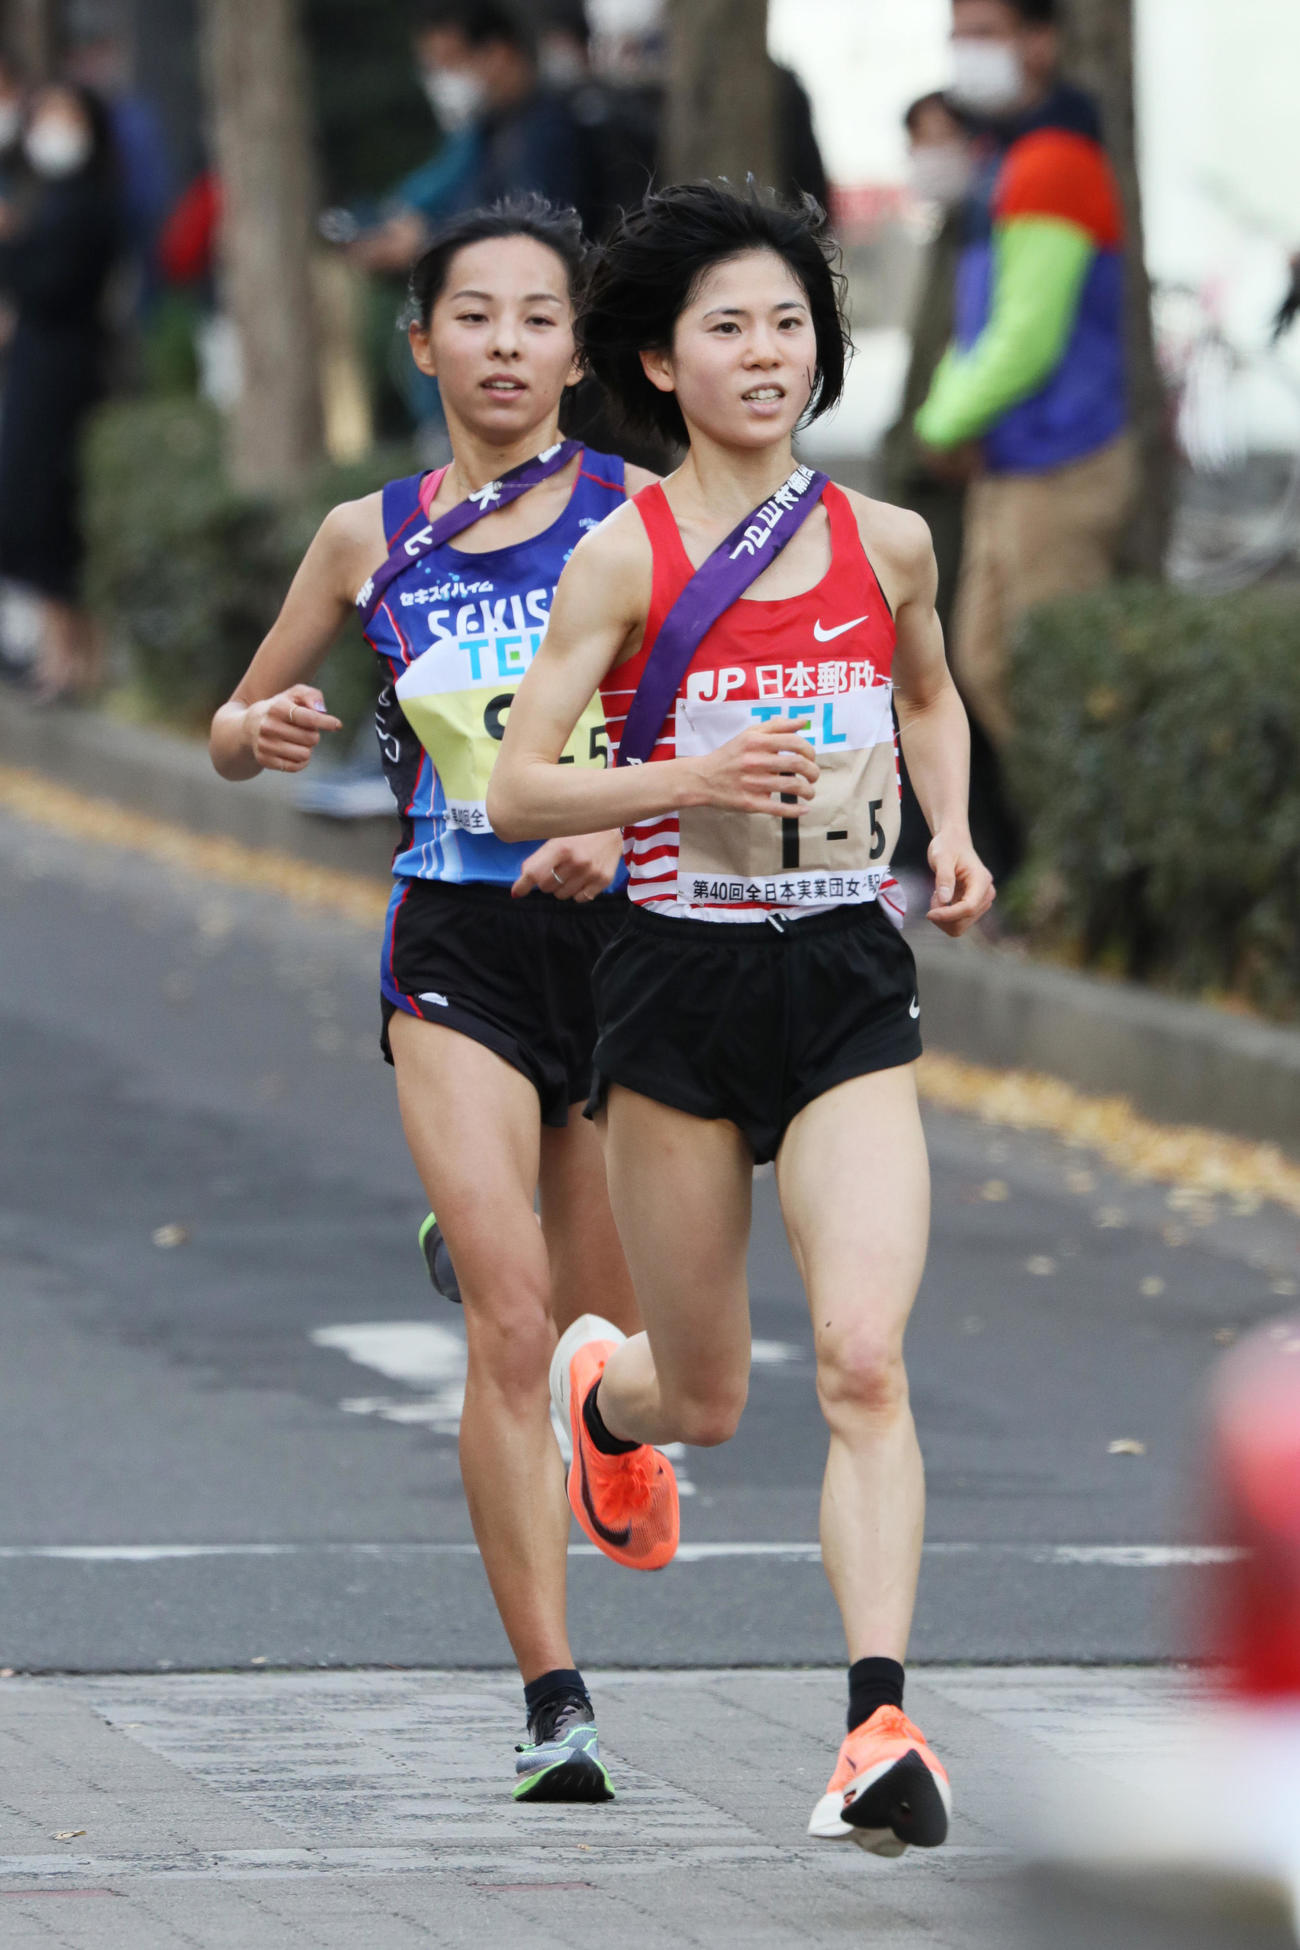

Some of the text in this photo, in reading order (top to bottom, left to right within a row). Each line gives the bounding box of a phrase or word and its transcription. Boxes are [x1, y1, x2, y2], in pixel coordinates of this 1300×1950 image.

[399, 580, 494, 607] セキスイハイム
[427, 586, 557, 641] SEKIS
[687, 660, 876, 702] JP 日本郵政
